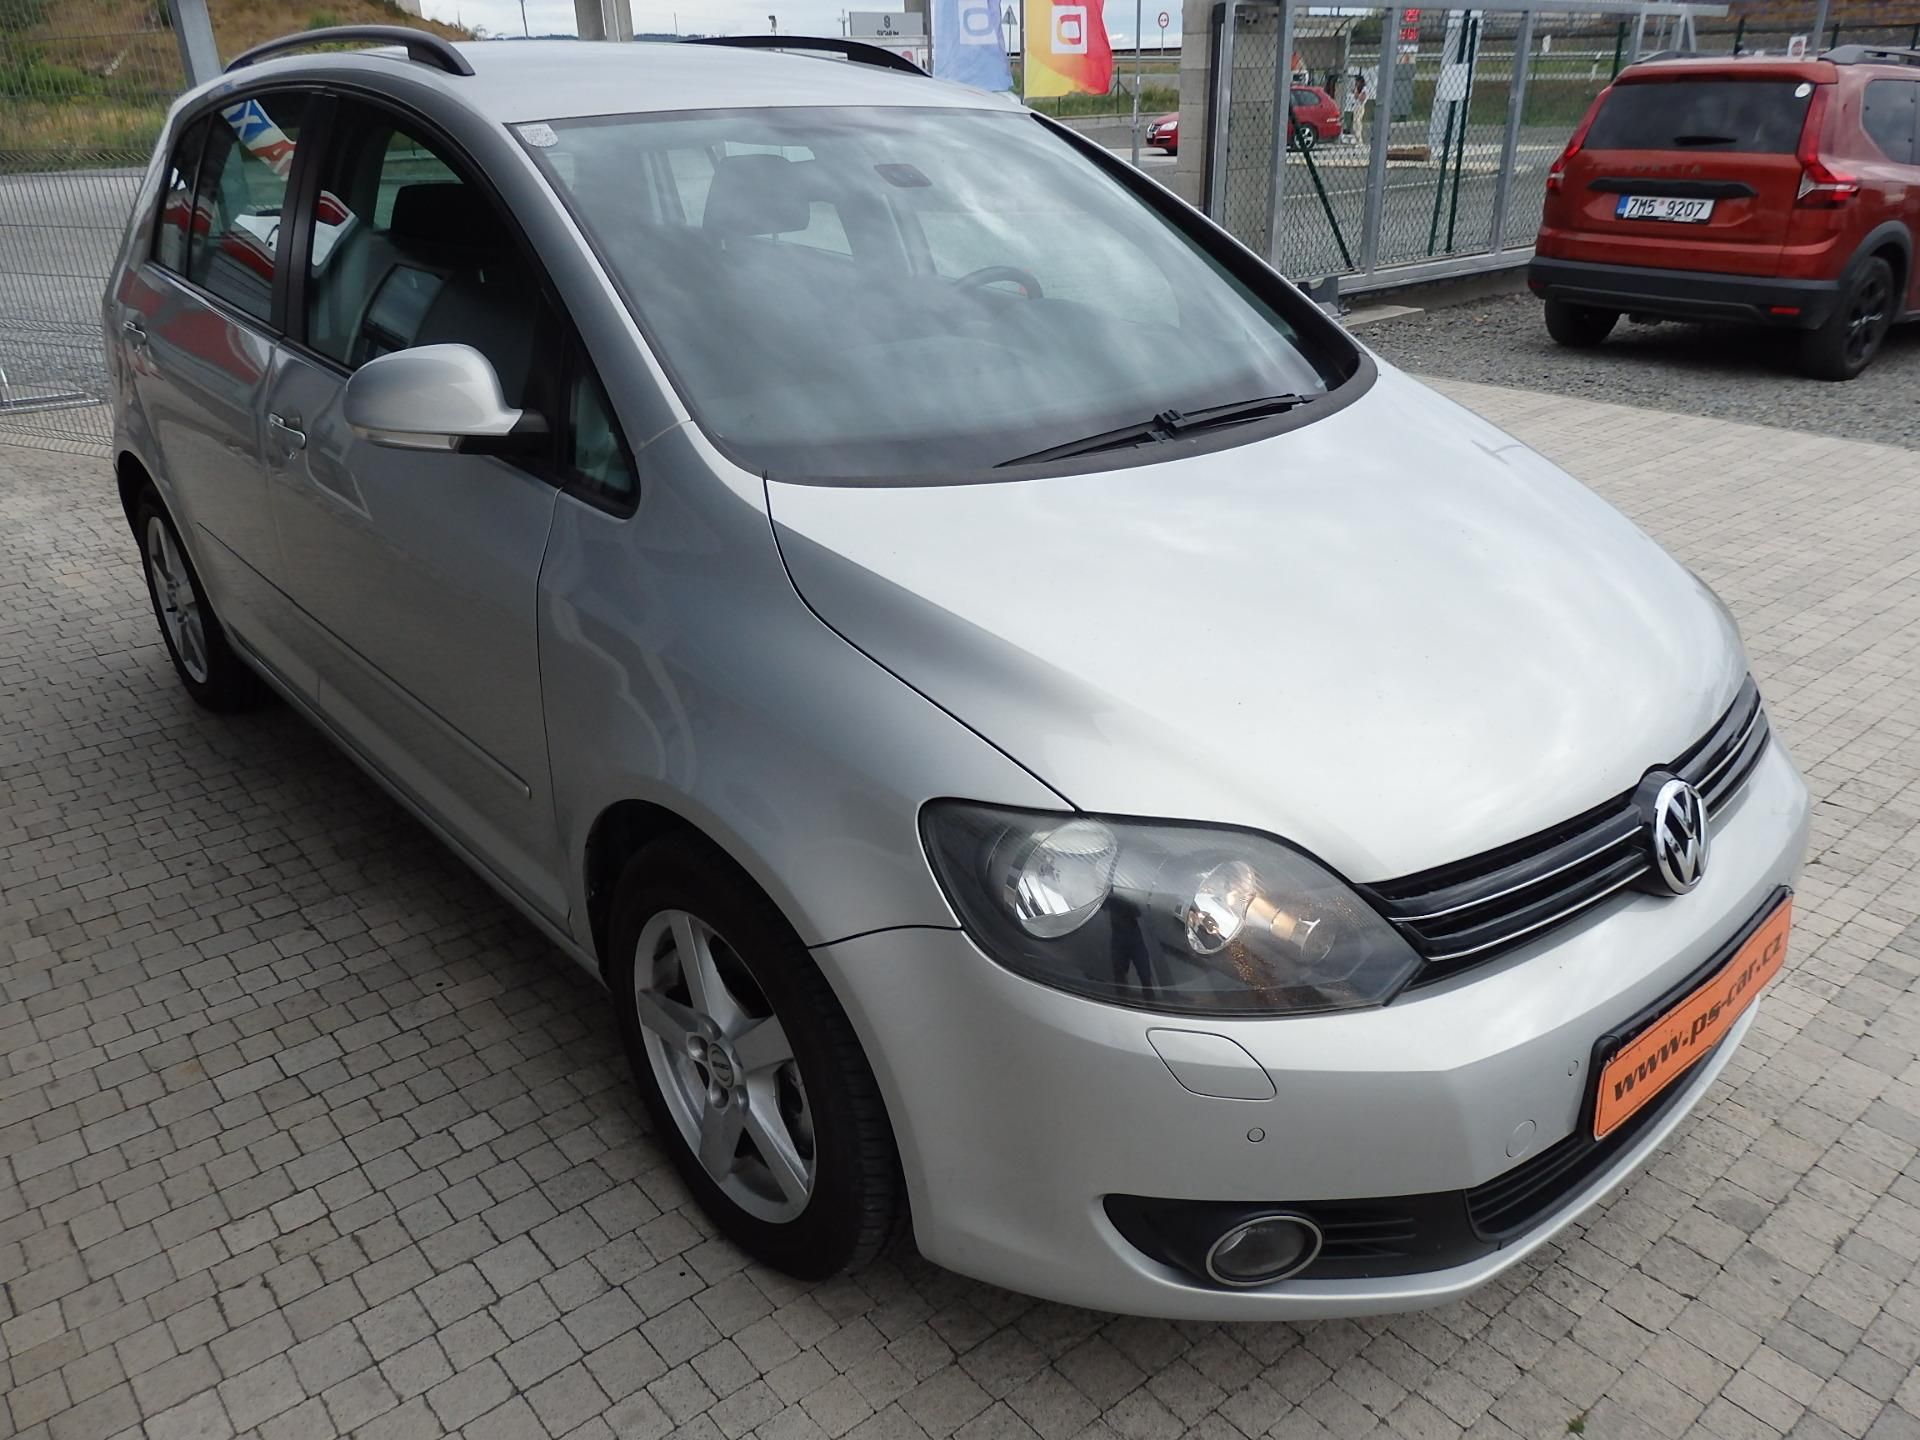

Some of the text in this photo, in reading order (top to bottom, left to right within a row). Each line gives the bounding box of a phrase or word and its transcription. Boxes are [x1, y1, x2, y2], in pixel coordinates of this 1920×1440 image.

[1628, 198, 1706, 218] 7M5 9207
[1614, 932, 1783, 1102] www.ps-car.cz
